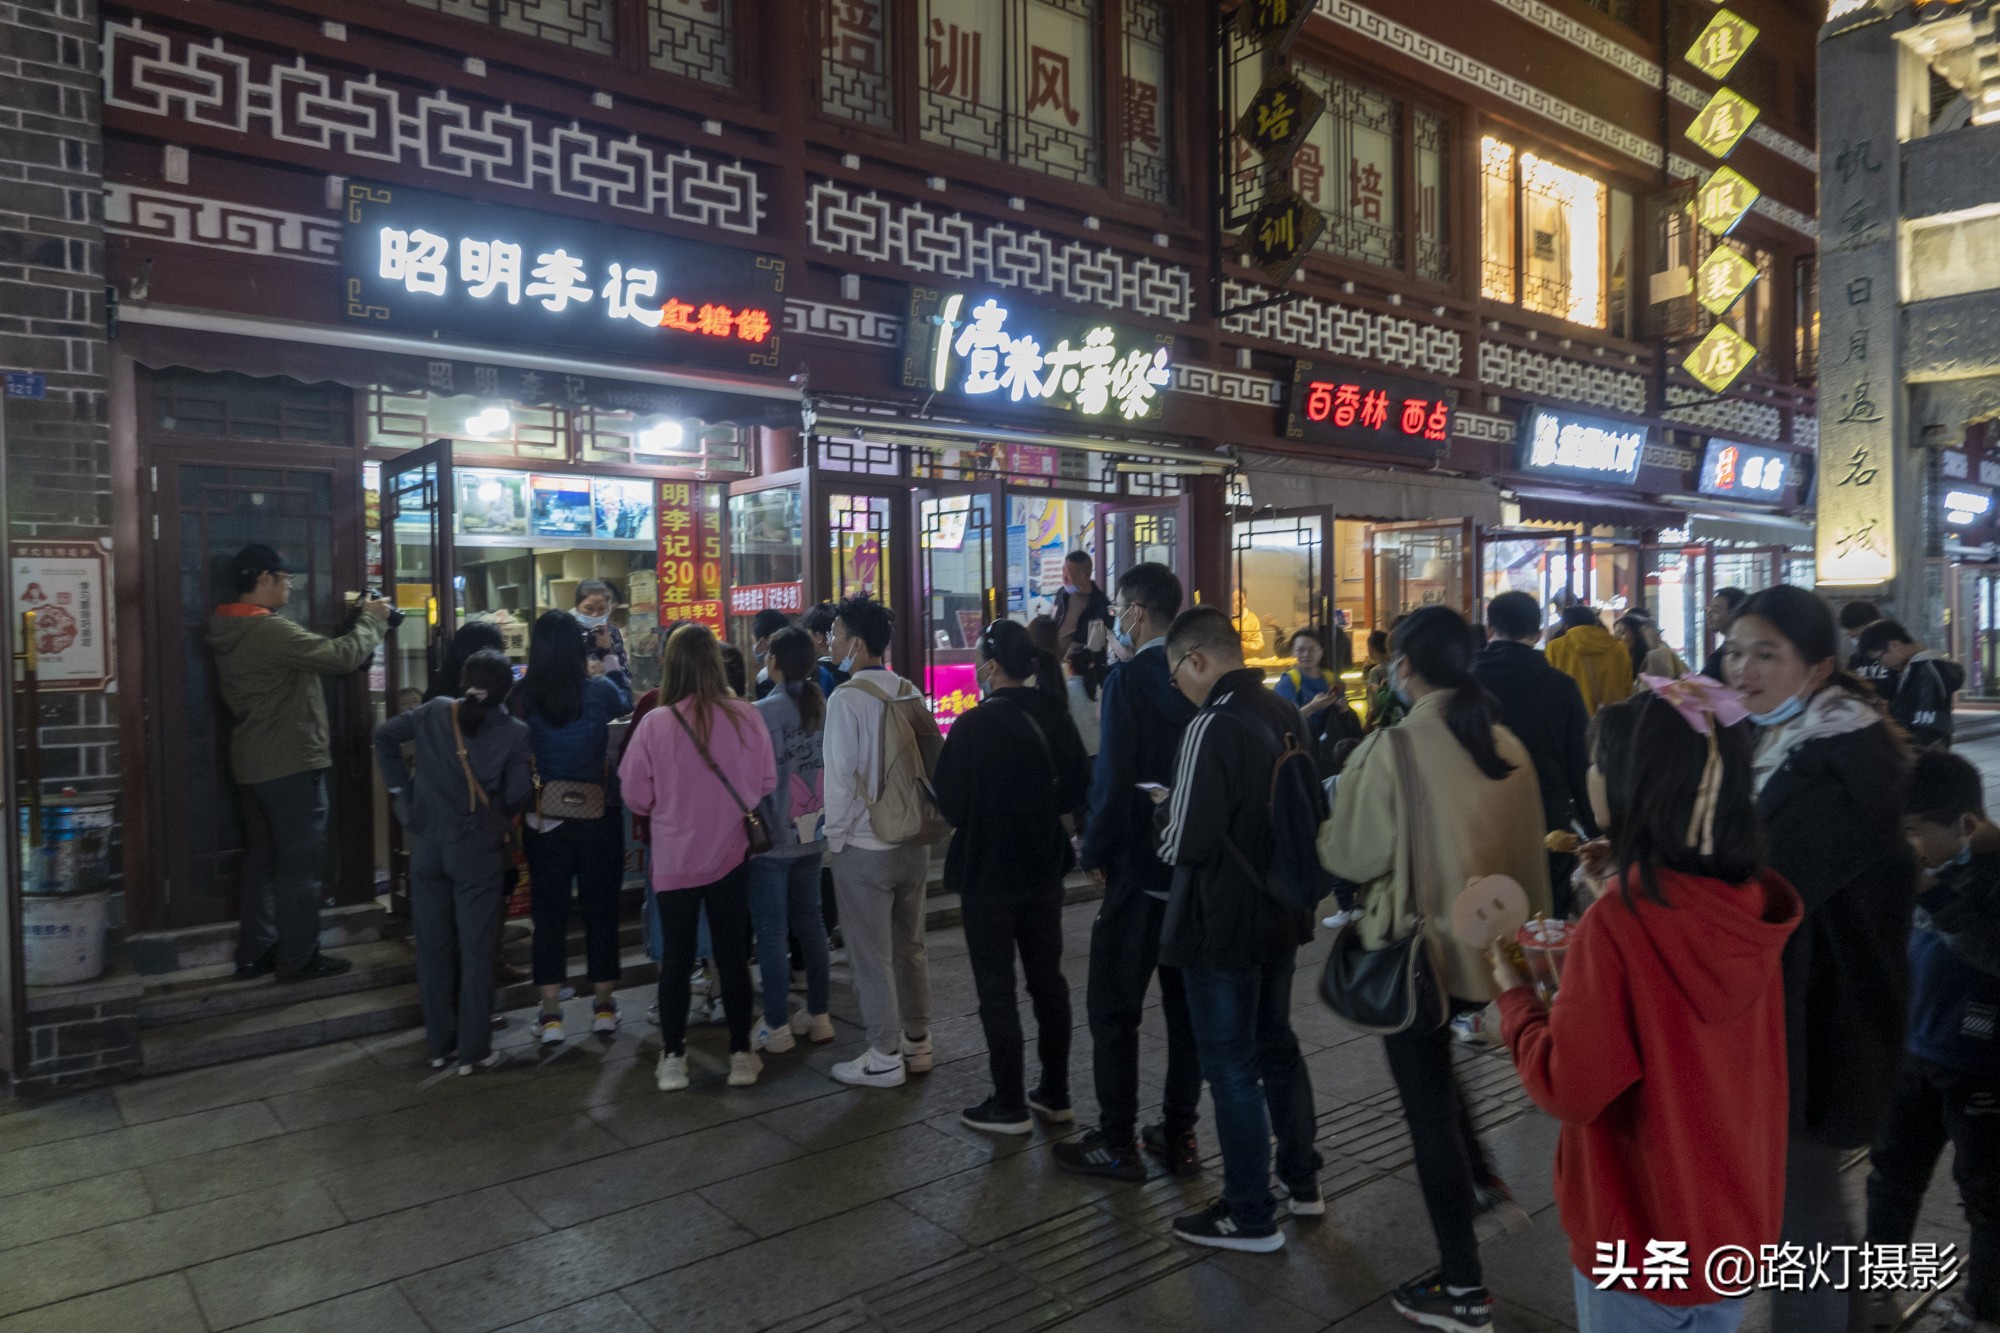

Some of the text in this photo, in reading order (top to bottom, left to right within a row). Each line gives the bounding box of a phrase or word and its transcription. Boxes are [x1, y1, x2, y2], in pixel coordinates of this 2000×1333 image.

[379, 227, 772, 343] 昭明李记 红糖饼
[428, 360, 588, 404] 昭明李记
[1307, 381, 1449, 441] 百香林 西点
[666, 602, 718, 621] 昭明李记
